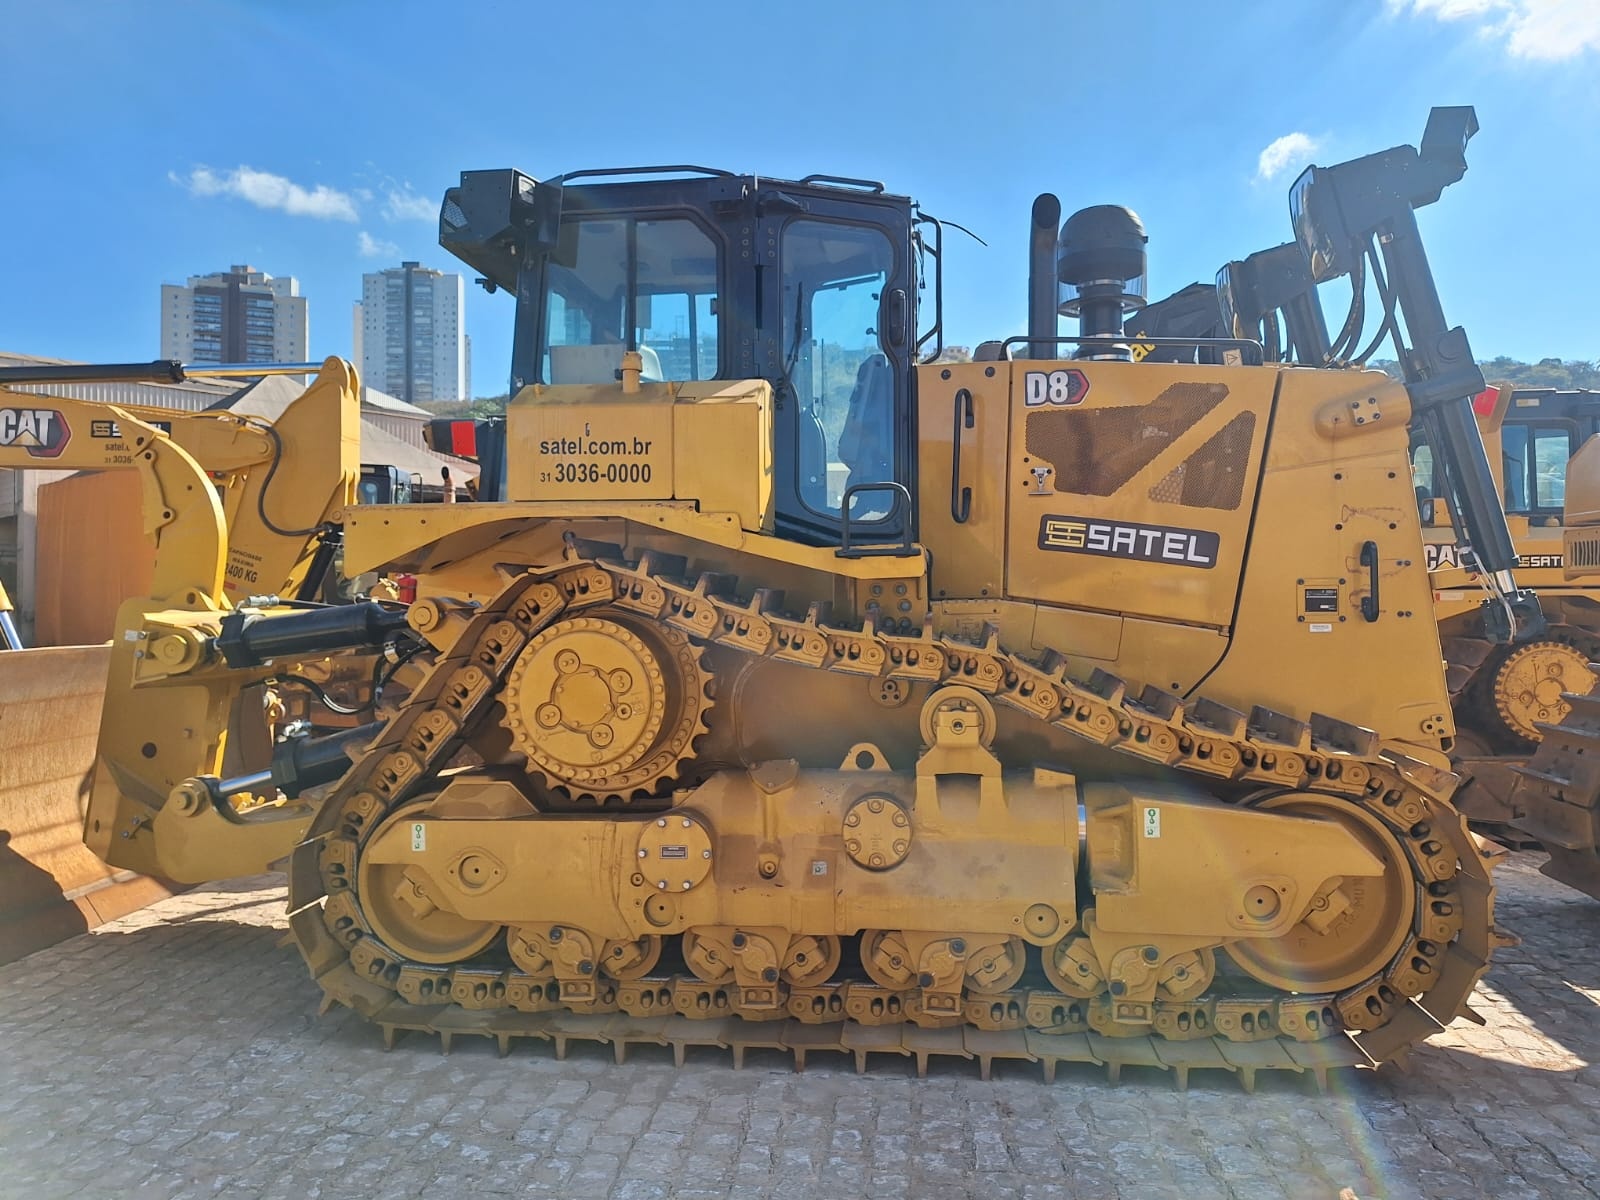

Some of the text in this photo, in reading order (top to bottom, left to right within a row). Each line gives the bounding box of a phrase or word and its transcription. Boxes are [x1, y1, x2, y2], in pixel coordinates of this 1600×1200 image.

[1027, 371, 1068, 404] D8
[0, 409, 54, 446] CAT
[540, 437, 652, 455] satel.com.br
[540, 463, 651, 483] 31 3036-0000
[1087, 524, 1210, 563] SATEL
[244, 569, 258, 583] KG
